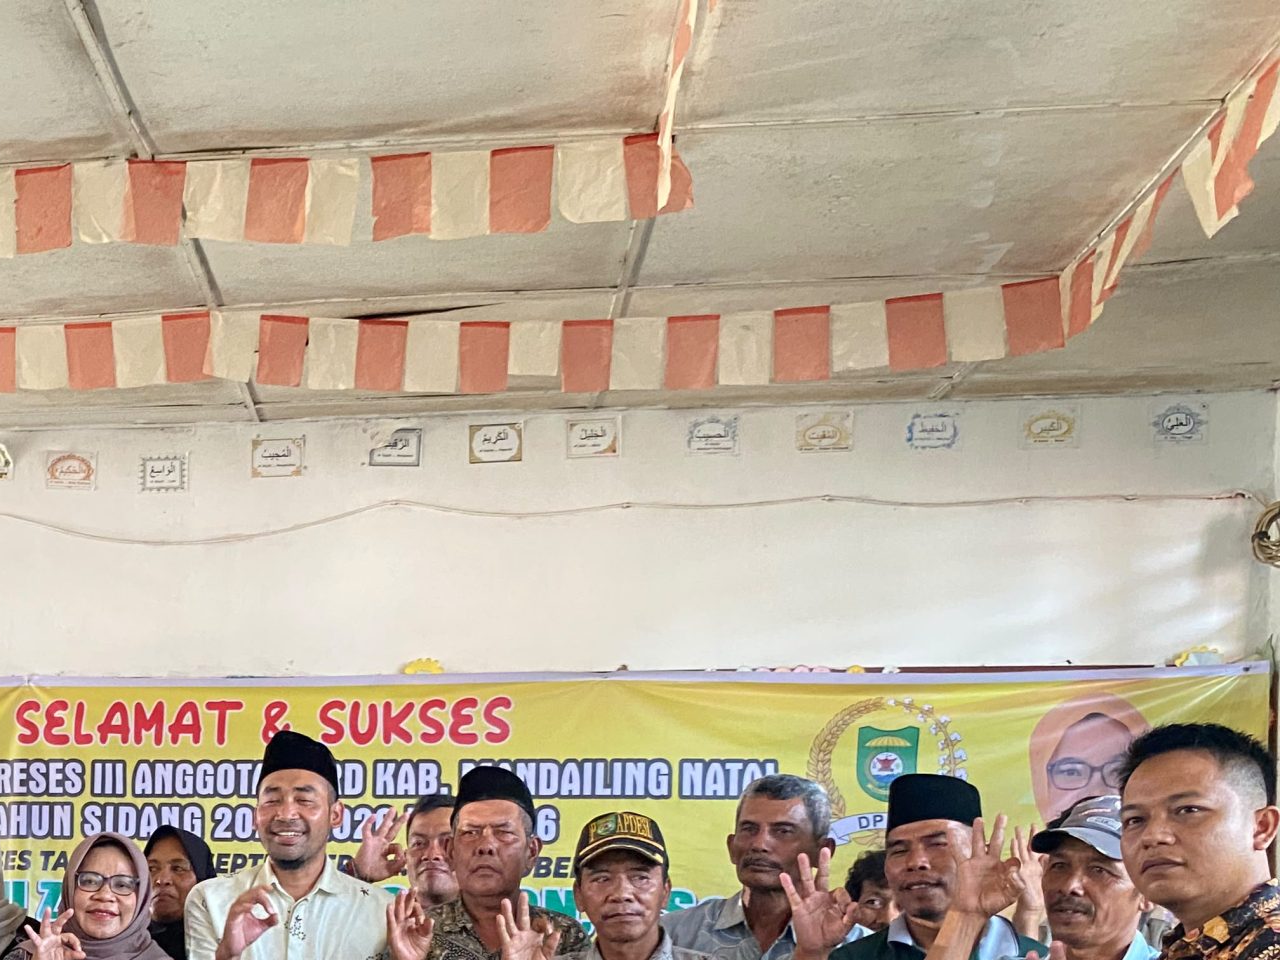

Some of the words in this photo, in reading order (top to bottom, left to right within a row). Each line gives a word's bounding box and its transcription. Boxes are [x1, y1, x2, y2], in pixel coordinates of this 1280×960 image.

[15, 698, 244, 746] SELAMAT
[261, 700, 291, 739] &
[318, 696, 513, 745] SUKSES
[93, 761, 125, 796] III
[375, 760, 450, 797] KAB.
[83, 804, 203, 840] SIDANG
